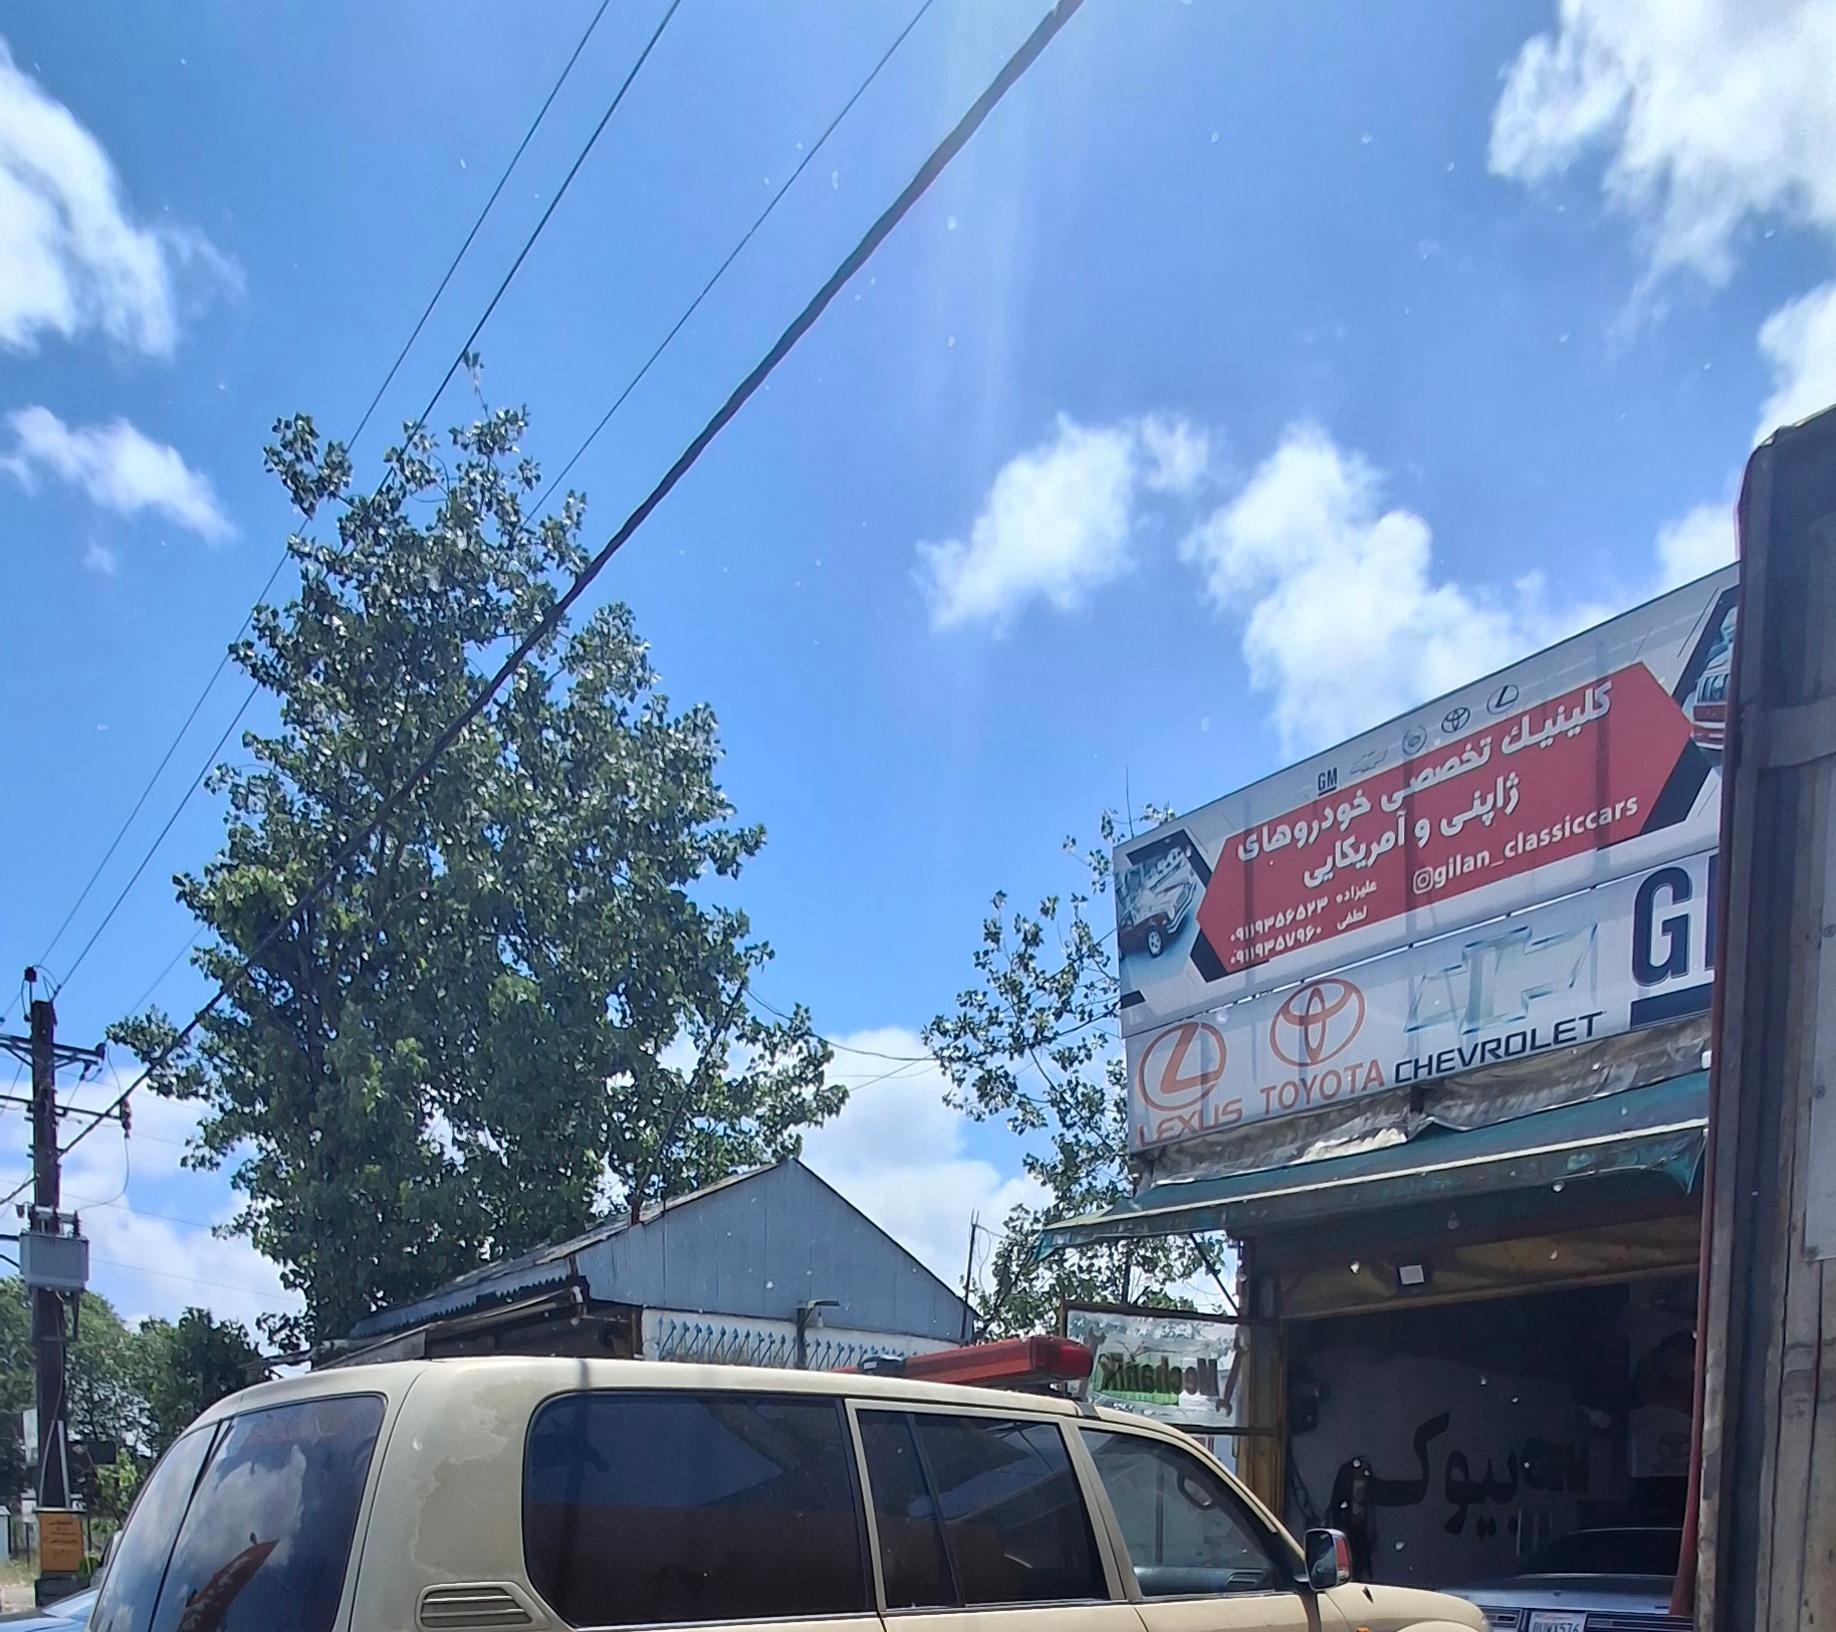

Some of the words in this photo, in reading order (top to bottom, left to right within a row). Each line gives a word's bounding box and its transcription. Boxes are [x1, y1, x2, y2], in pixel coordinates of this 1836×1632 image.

[1317, 767, 1338, 791] GM
[1380, 736, 1493, 812] تخصصی
[1440, 771, 1520, 838] ژاپنی
[1237, 789, 1372, 862] خودروهای
[1303, 810, 1407, 888] آمریکایی
[1414, 818, 1431, 849] و
[1433, 796, 1639, 890] gilan_classiccars
[1335, 880, 1378, 904] علیزاده
[1336, 905, 1368, 931] لطفی
[1632, 855, 1716, 988] G
[1393, 1010, 1607, 1085] CHEVROLET
[1259, 1059, 1385, 1115] TOYOTA
[1137, 1097, 1243, 1148] LEXUS
